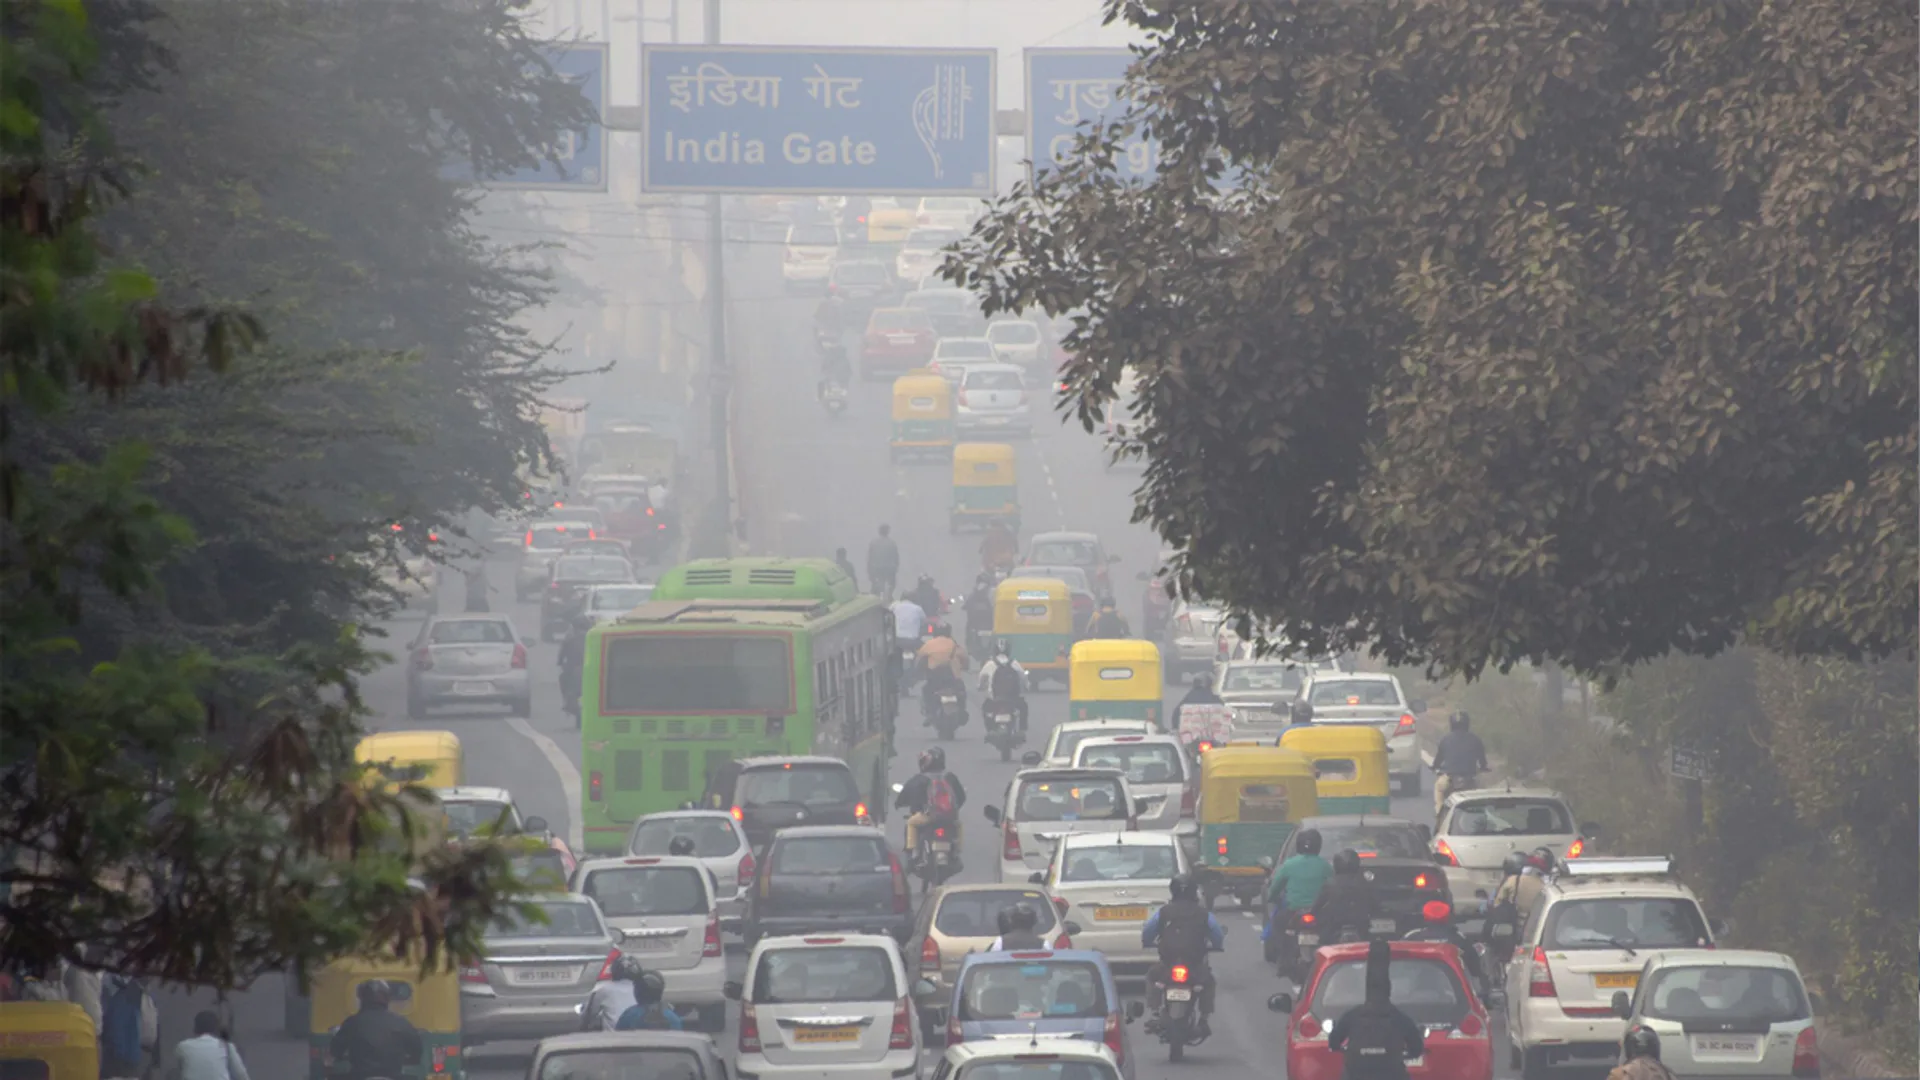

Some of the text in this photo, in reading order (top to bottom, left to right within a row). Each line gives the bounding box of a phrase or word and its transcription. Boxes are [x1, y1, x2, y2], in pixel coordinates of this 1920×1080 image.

[666, 62, 864, 113] इंडिया गेट
[664, 130, 877, 166] India Gate
